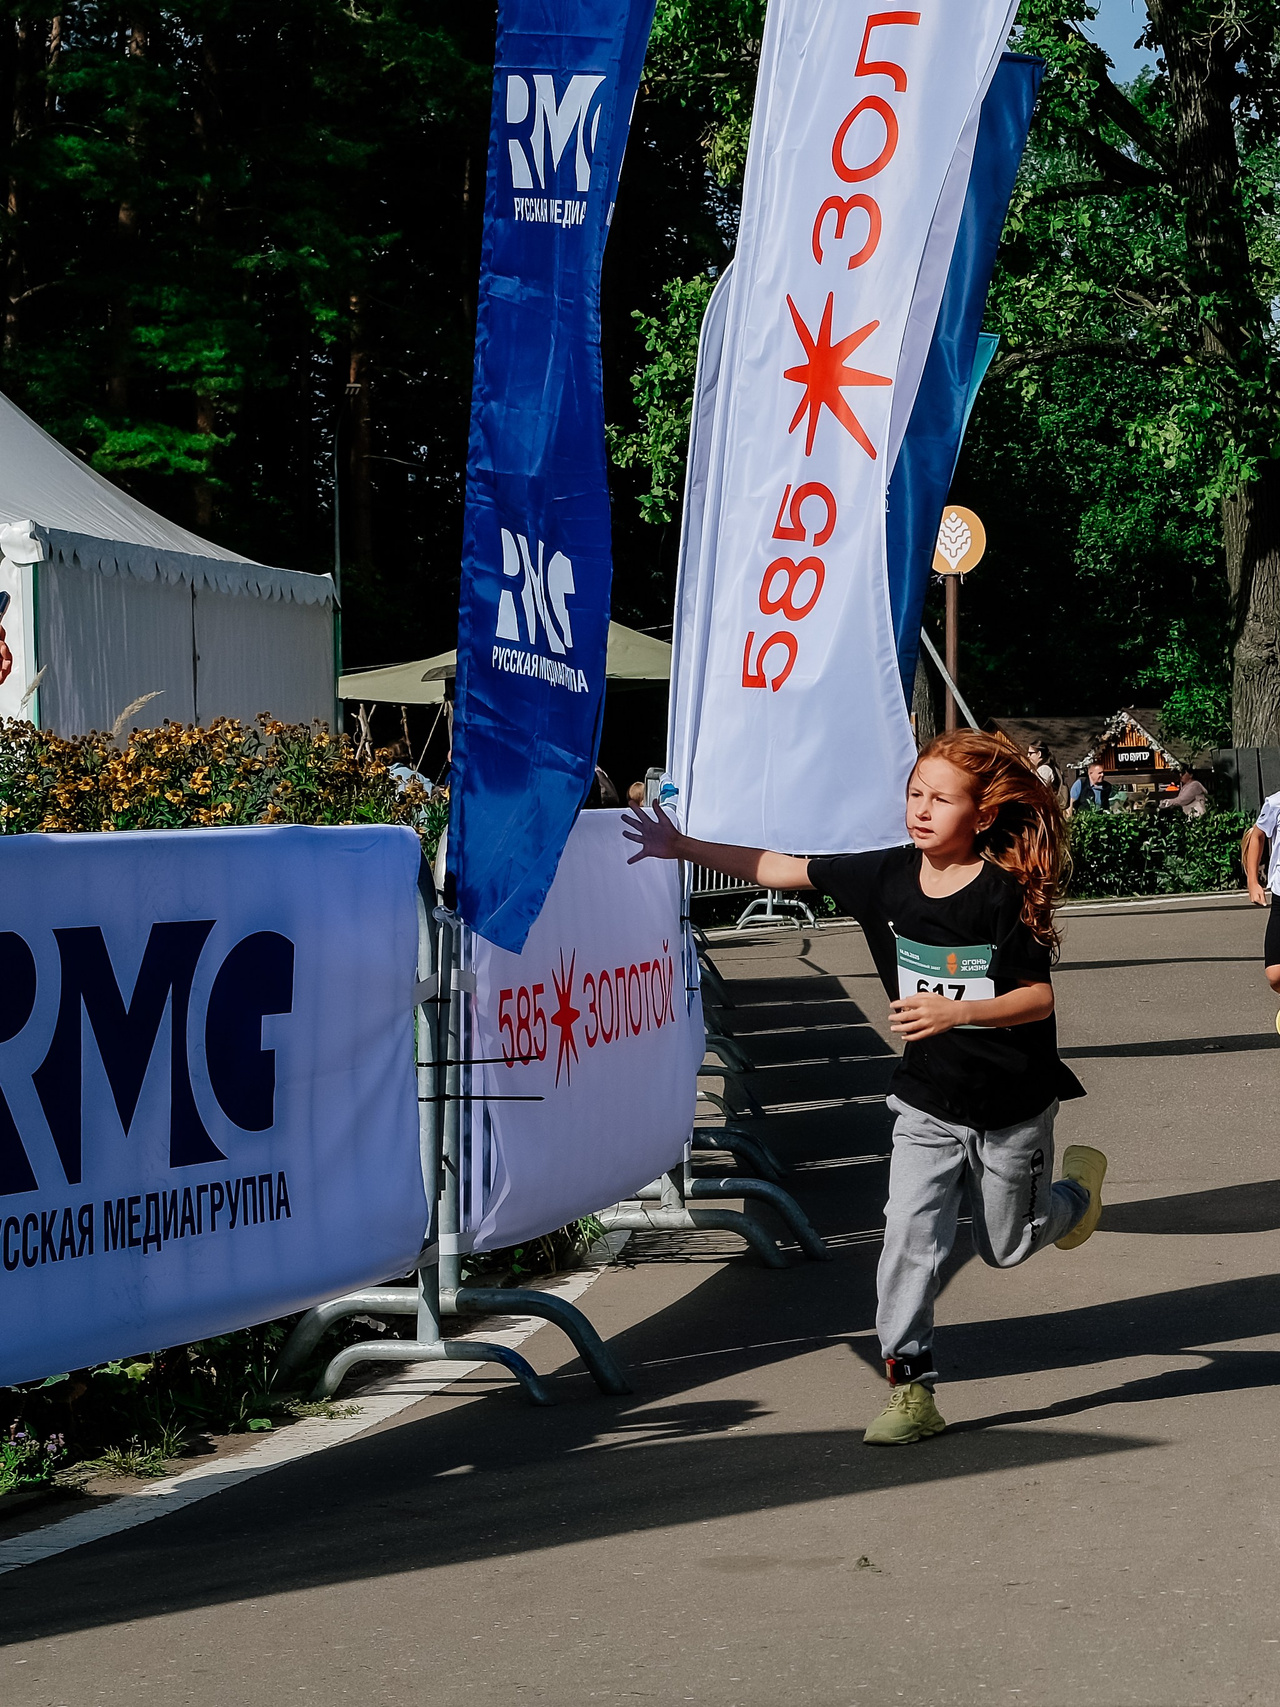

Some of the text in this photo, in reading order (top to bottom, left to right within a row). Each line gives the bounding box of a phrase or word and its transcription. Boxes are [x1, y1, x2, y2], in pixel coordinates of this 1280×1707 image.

[506, 74, 607, 192] RM
[742, 11, 921, 692] 585 ЗОЛ
[496, 527, 576, 655] RMG
[492, 645, 538, 677] РУССКАЯ
[499, 938, 676, 1068] 585 ЗОЛОТОЙ
[960, 964, 989, 972] ЖИЗНИ
[961, 958, 987, 966] ОГОНЬ
[0, 1170, 292, 1273] ССКАЯ МЕДИАГРУППА
[1022, 1148, 1045, 1242] Champio
